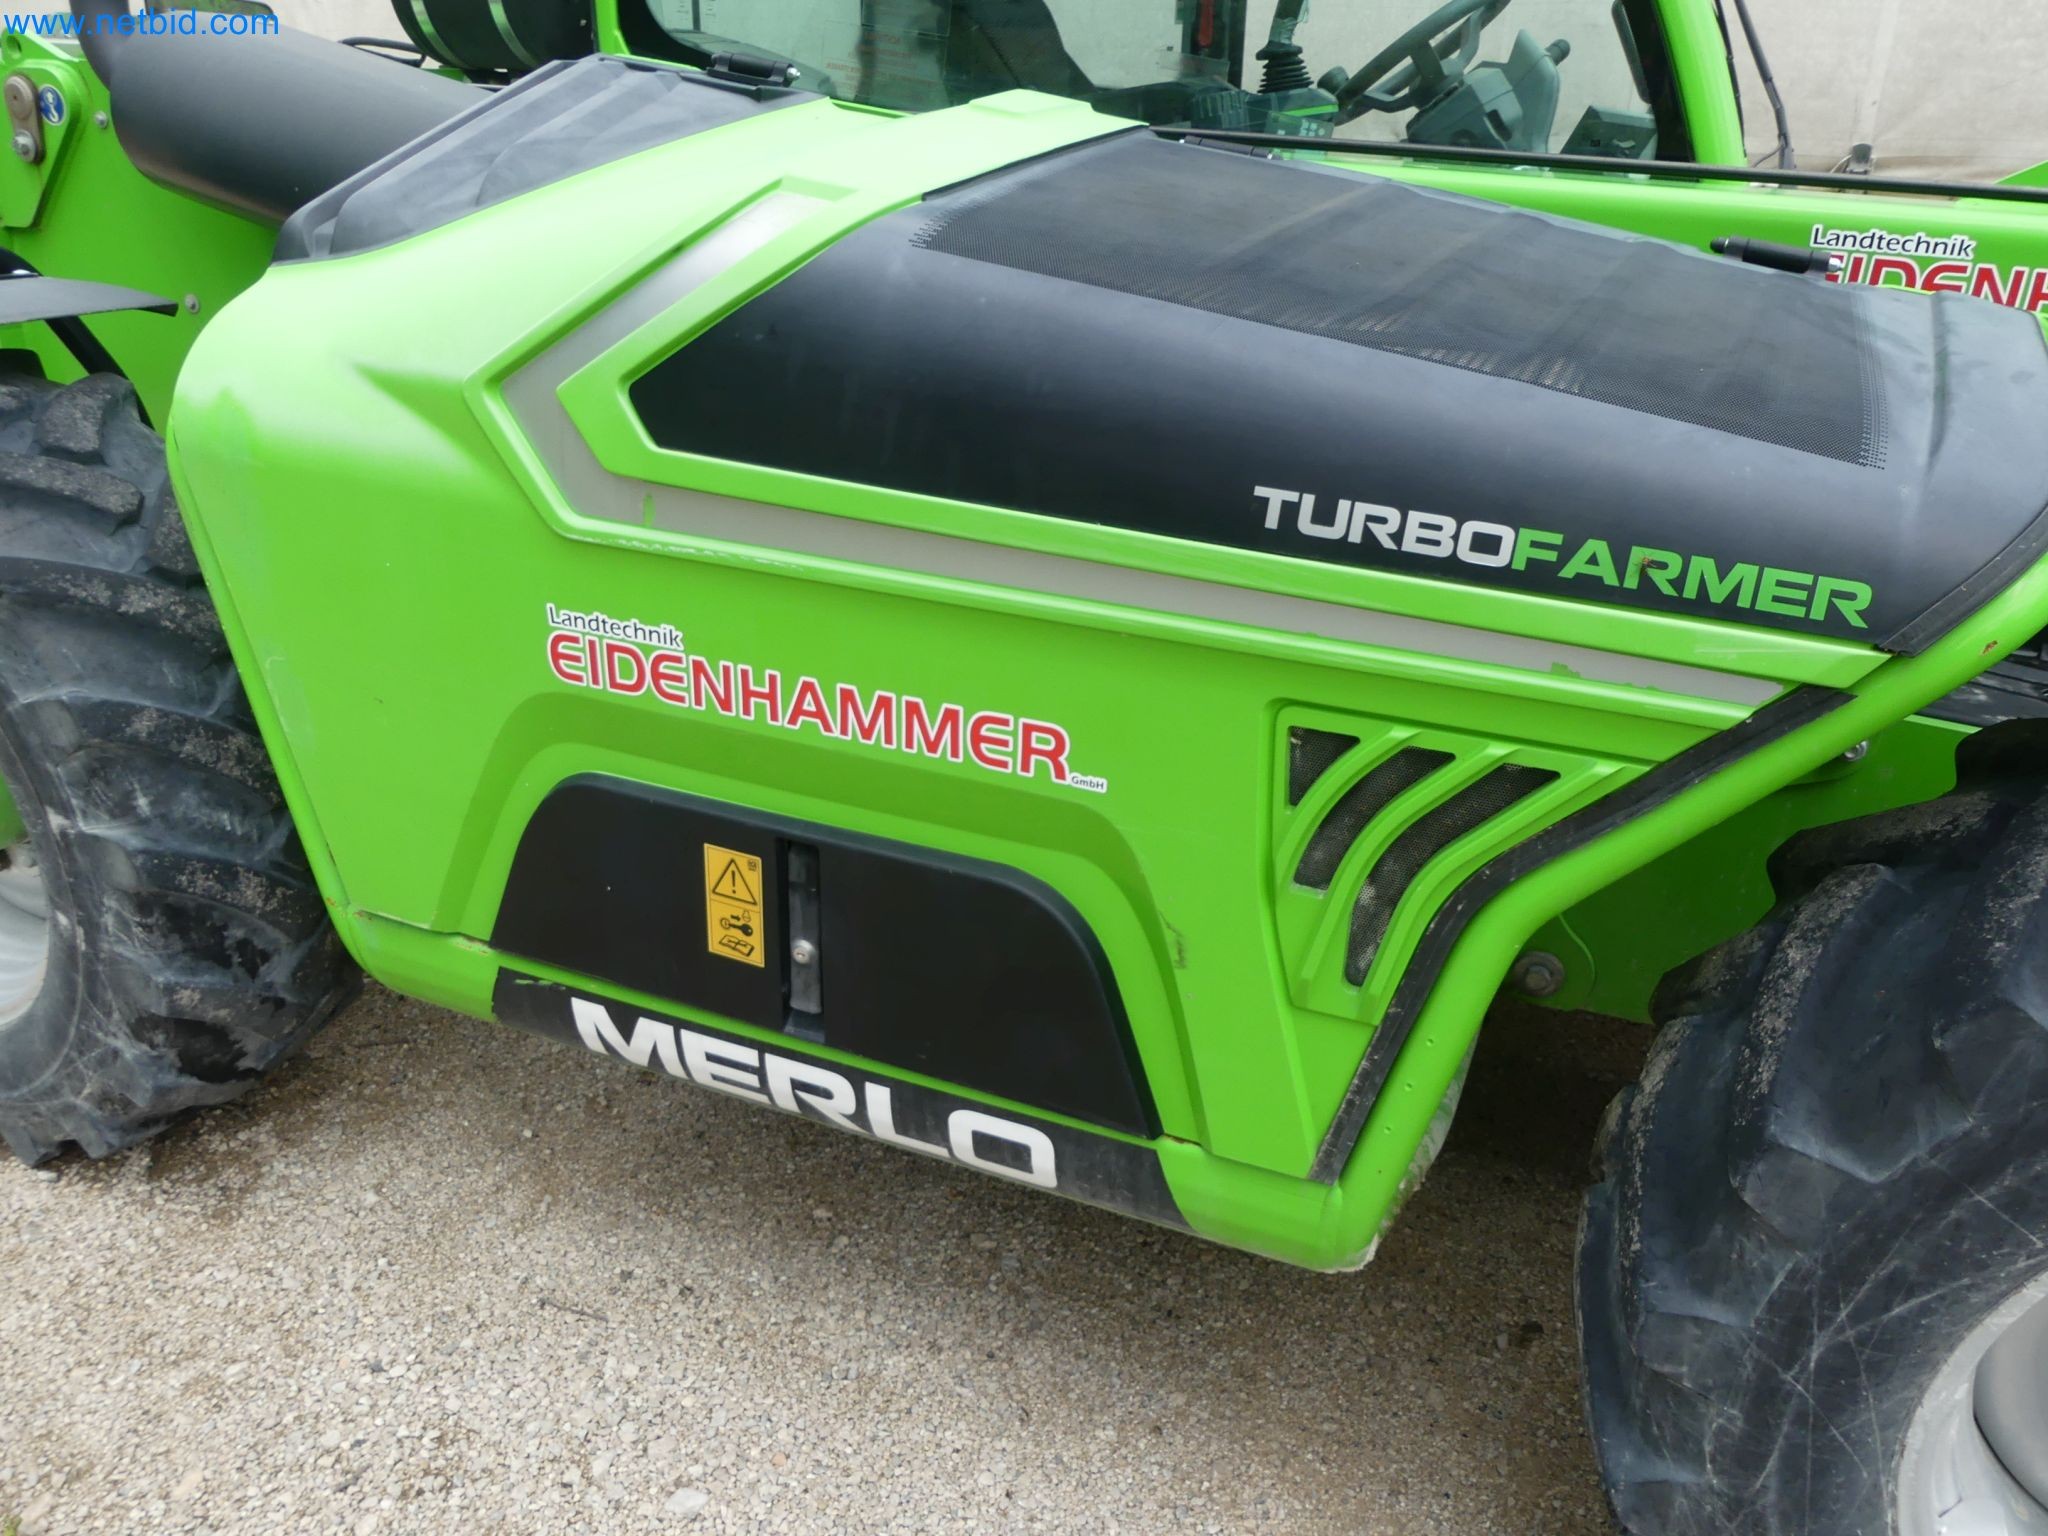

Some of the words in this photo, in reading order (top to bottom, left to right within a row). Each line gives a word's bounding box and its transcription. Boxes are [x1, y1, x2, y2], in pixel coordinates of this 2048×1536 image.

[1812, 226, 1975, 258] Landtechnik
[548, 605, 682, 648] Landtechnik
[1253, 485, 1873, 629] TURBOFARMER
[549, 632, 1068, 782] EIDENHAMMER
[1070, 774, 1105, 791] GmbH
[570, 996, 1058, 1189] MERLO
